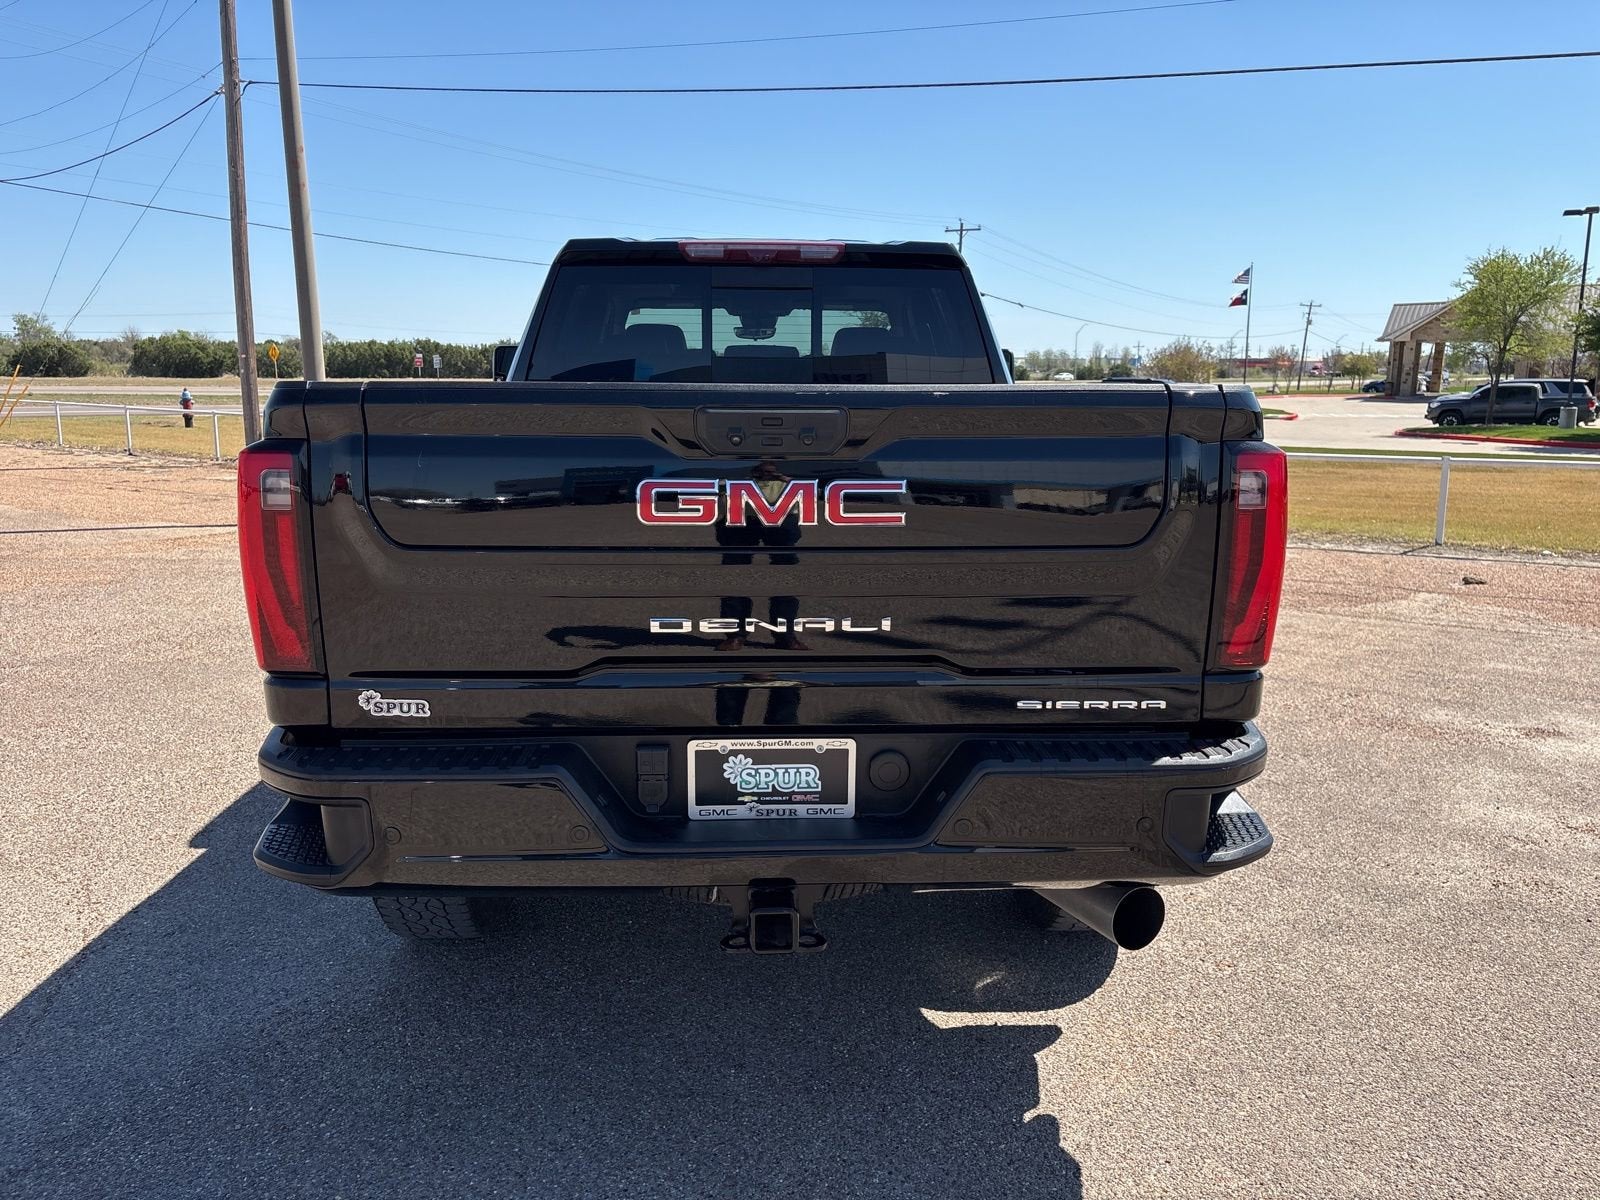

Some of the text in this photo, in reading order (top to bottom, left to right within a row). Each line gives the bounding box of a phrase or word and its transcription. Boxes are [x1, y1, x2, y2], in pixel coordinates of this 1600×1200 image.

[636, 478, 907, 526] GMC
[650, 617, 892, 633] DENALI
[373, 701, 427, 714] SPUR
[1016, 700, 1167, 710] SIERRA
[730, 740, 814, 748] www.SpurGM.com
[738, 765, 819, 791] SPUR
[791, 794, 820, 802] GMC
[698, 807, 845, 817] GMC SPUR GMC
